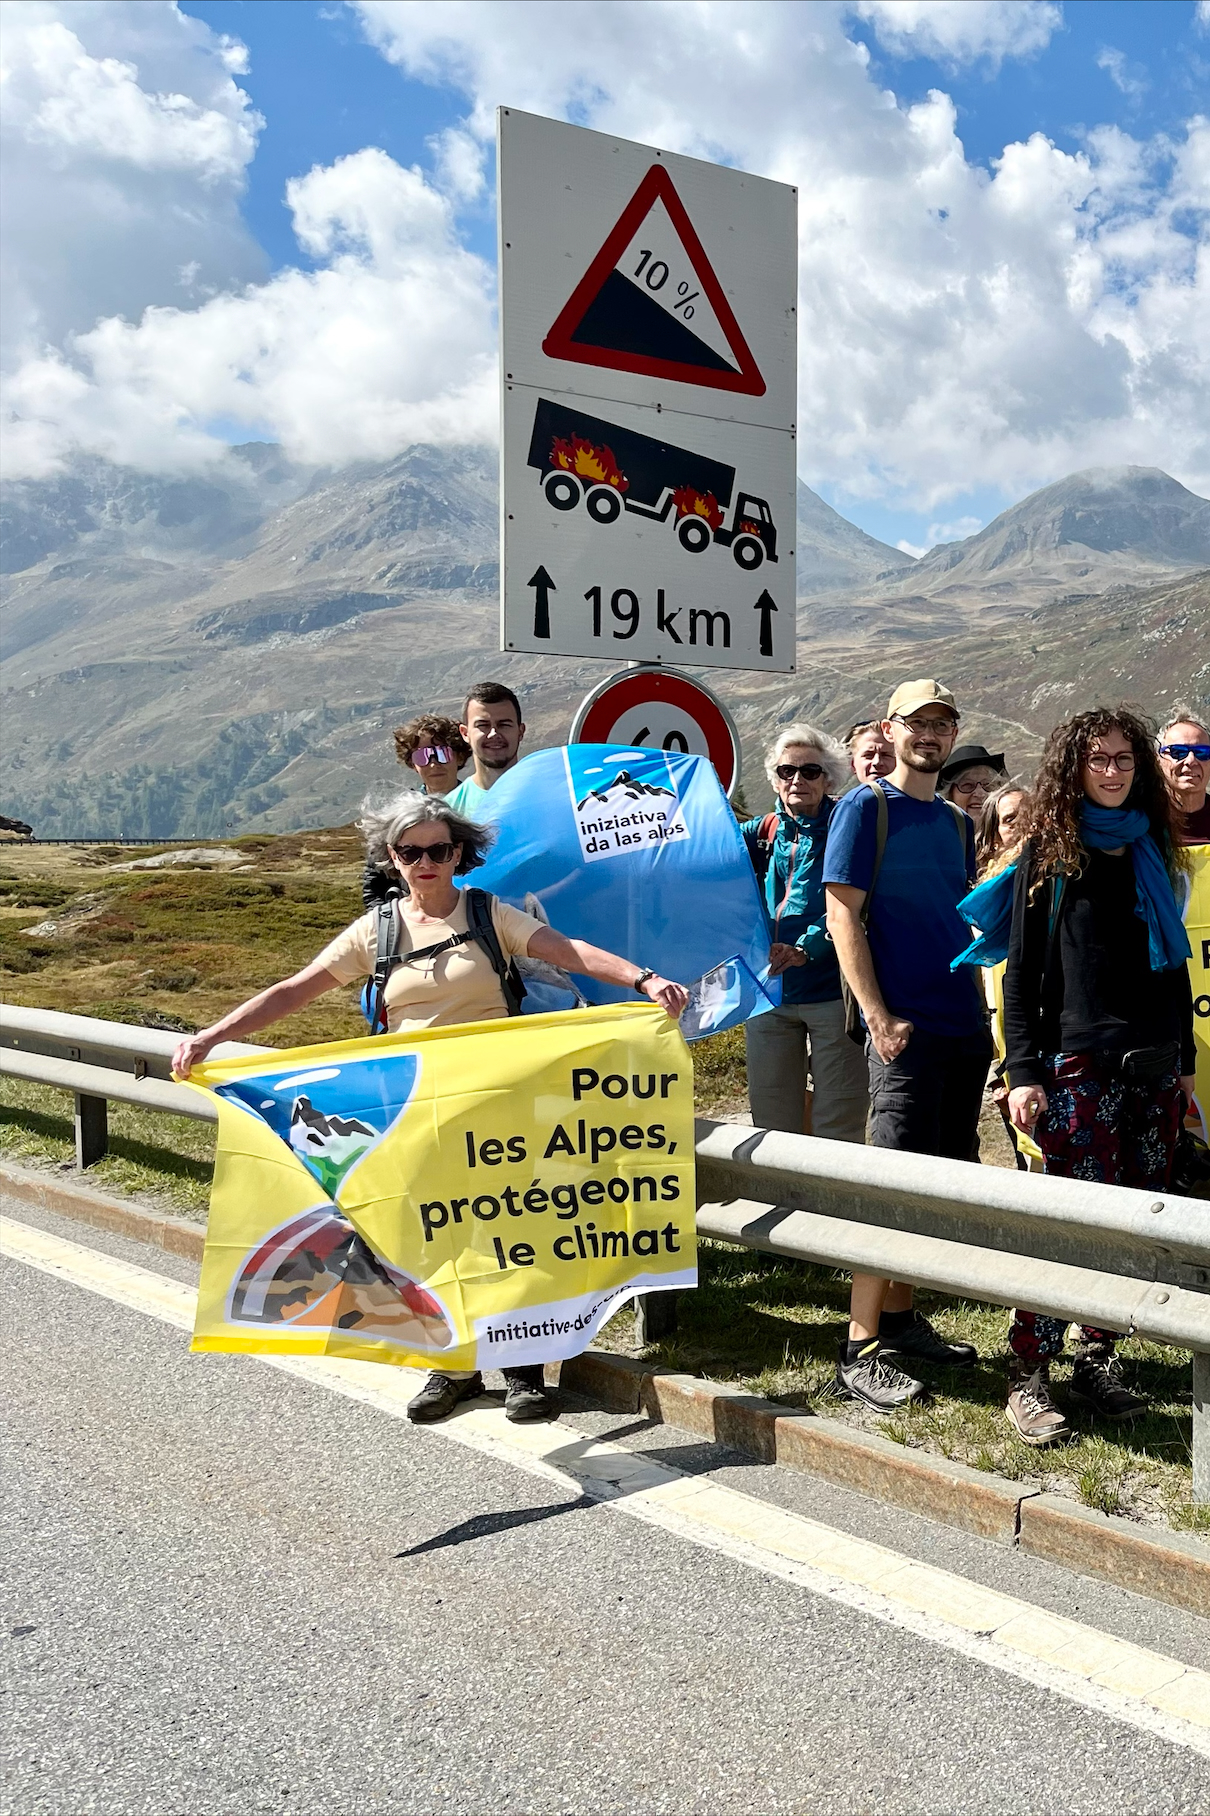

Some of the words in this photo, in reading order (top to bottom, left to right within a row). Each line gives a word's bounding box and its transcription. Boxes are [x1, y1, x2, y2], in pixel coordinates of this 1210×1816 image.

[633, 249, 669, 291] 10
[673, 281, 700, 320] %
[583, 585, 640, 640] 19
[656, 588, 731, 648] km
[580, 810, 667, 836] iniziativa
[585, 836, 611, 854] da
[614, 831, 642, 847] las
[648, 822, 685, 840] alps
[572, 1067, 679, 1101] Pour
[465, 1131, 527, 1168] les
[543, 1119, 678, 1163] Alpes,
[419, 1175, 680, 1242] protégeons
[492, 1237, 536, 1269] le
[552, 1222, 680, 1261] climat
